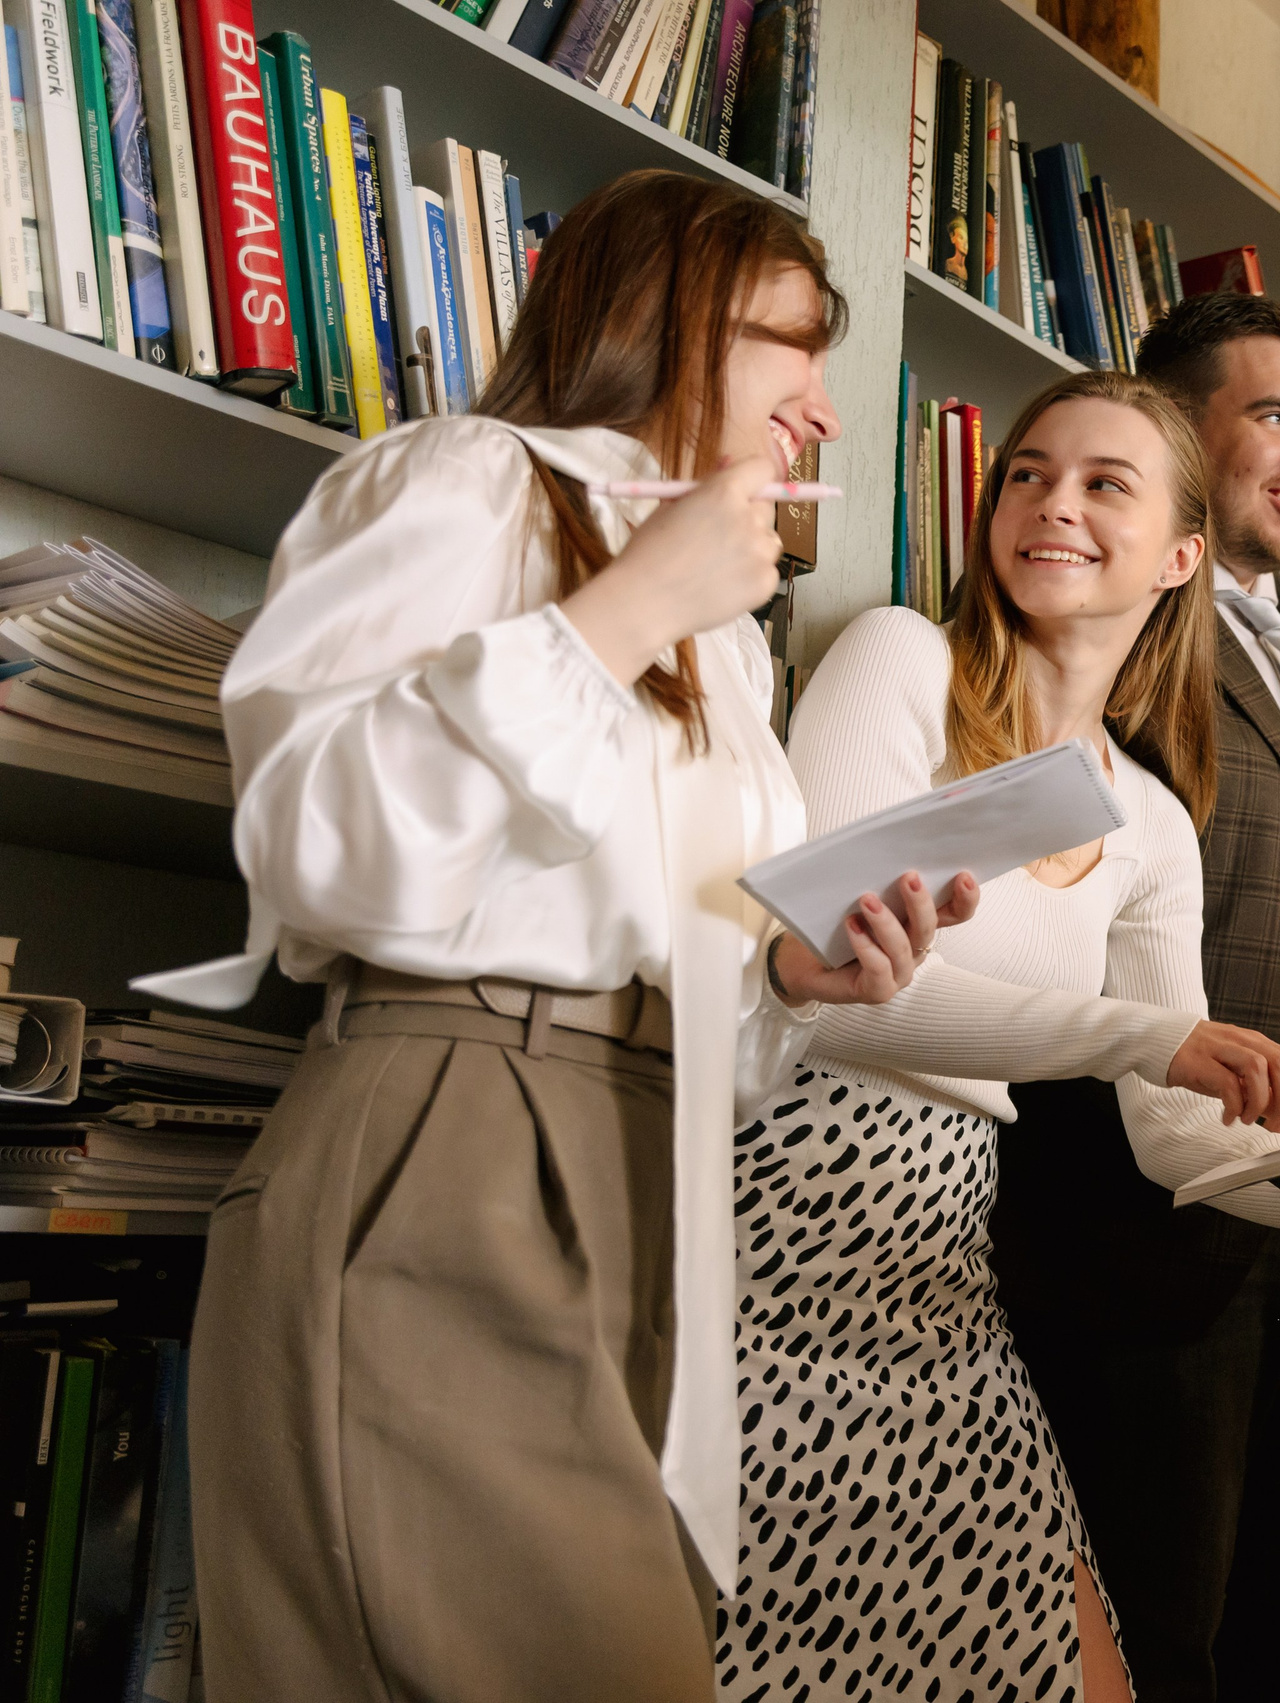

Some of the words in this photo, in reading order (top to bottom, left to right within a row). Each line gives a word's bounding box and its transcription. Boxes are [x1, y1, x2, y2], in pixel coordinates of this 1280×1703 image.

[39, 0, 64, 97] Fieldwork
[623, 18, 647, 62] БЛОКАДНОГО
[658, 1, 685, 66] ARCHITECTURE
[165, 48, 173, 58] LA
[167, 68, 179, 103] JARDINS
[266, 70, 274, 107] Inspiration
[300, 53, 315, 109] Urban
[720, 20, 747, 125] ARCHITECTURE
[12, 105, 27, 157] Overlooking
[172, 104, 181, 131] PETITS
[396, 107, 407, 152] БРОНЗЕ
[964, 78, 972, 147] ИСКУССТВА
[271, 117, 279, 155] Landscape
[304, 112, 323, 175] Spaces
[18, 159, 27, 175] the
[177, 144, 187, 180] STRONG
[218, 22, 286, 327] BAUHAUS
[403, 166, 411, 191] ШАГ
[19, 175, 30, 201] visual
[181, 180, 189, 199] ROY
[315, 194, 322, 202] 4
[358, 182, 366, 206] Pattern
[363, 171, 374, 206] Patios,
[368, 145, 378, 180] Garden
[373, 181, 383, 219] Lighting
[952, 152, 963, 211] ИСТОРИЯ
[960, 148, 970, 215] МИРОВОГО
[138, 180, 159, 241] Landscape
[492, 189, 503, 214] The
[361, 207, 370, 239] Language
[367, 209, 382, 264] Driveways,
[459, 217, 467, 254] BUILDING
[472, 222, 480, 255] WALKING
[321, 253, 329, 278] Morris
[366, 248, 374, 277] Concrete
[493, 217, 513, 289] VILLAS
[324, 279, 332, 304] Dixon,
[375, 265, 384, 286] and
[1019, 242, 1030, 308] DUCHAMP
[377, 286, 389, 323] Plazas
[296, 360, 304, 392] Academy
[39, 1438, 48, 1464] NERI
[112, 1430, 132, 1463] You
[19, 1537, 36, 1624] CATALOGUE
[150, 1581, 194, 1665] light
[13, 1630, 25, 1666] 2007
